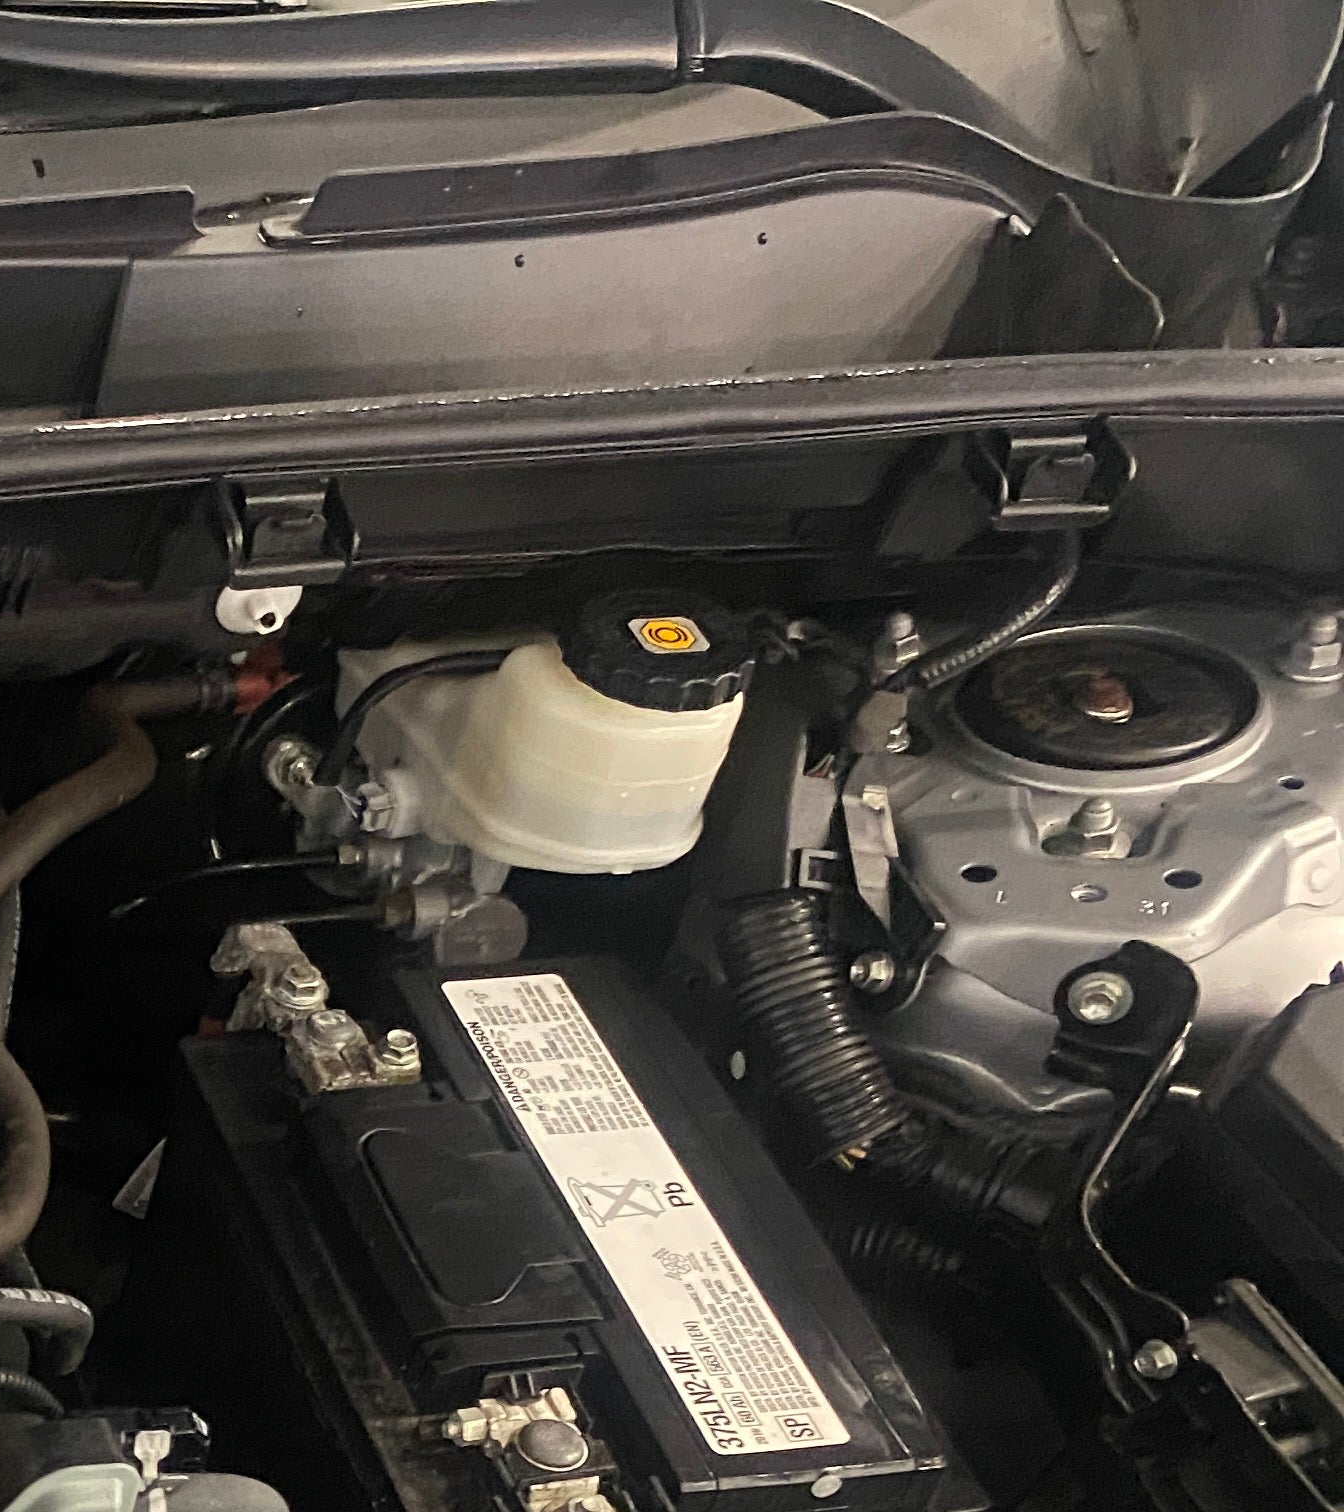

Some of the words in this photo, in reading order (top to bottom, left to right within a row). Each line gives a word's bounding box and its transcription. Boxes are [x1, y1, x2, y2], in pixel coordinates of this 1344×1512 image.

[663, 1181, 694, 1207] Pb
[682, 1321, 709, 1342] (EN)
[662, 1347, 744, 1448] 375LN2-MF
[784, 1418, 814, 1437] SP
